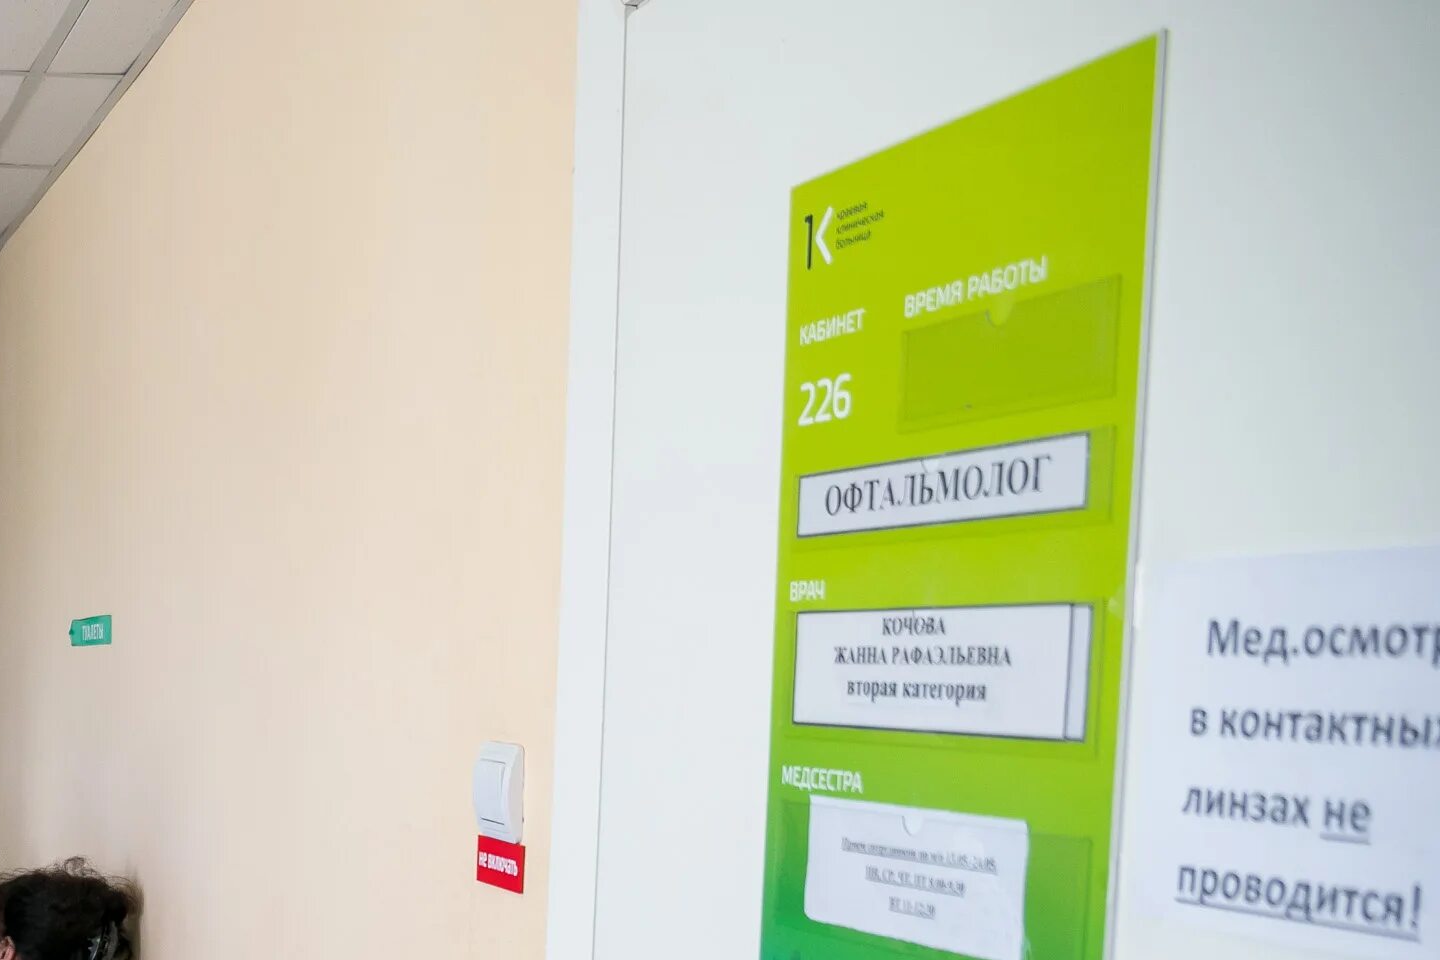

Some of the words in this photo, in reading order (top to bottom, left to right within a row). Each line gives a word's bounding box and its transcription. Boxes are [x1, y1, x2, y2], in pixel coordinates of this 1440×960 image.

[903, 280, 963, 319] ВРЕМЯ
[967, 255, 1049, 300] РАБОТЫ
[799, 308, 865, 346] КАБИНЕТ
[798, 373, 852, 426] 226
[825, 453, 1052, 517] ОФТАЛЬМОЛОГ
[789, 580, 825, 602] ВРАЧ
[882, 617, 947, 637] КОЧОВА
[834, 646, 888, 666] ЖАННА
[891, 646, 1012, 667] РАФАЭЛЬЕВНА
[847, 679, 897, 703] вторая
[902, 681, 987, 707] категория
[1191, 707, 1208, 736] в
[1220, 708, 1440, 749] контактны
[782, 765, 864, 794] МЕДСЕСТРА
[1182, 786, 1311, 829] линзах
[1323, 799, 1372, 838] не
[1176, 864, 1422, 934] проводится!
